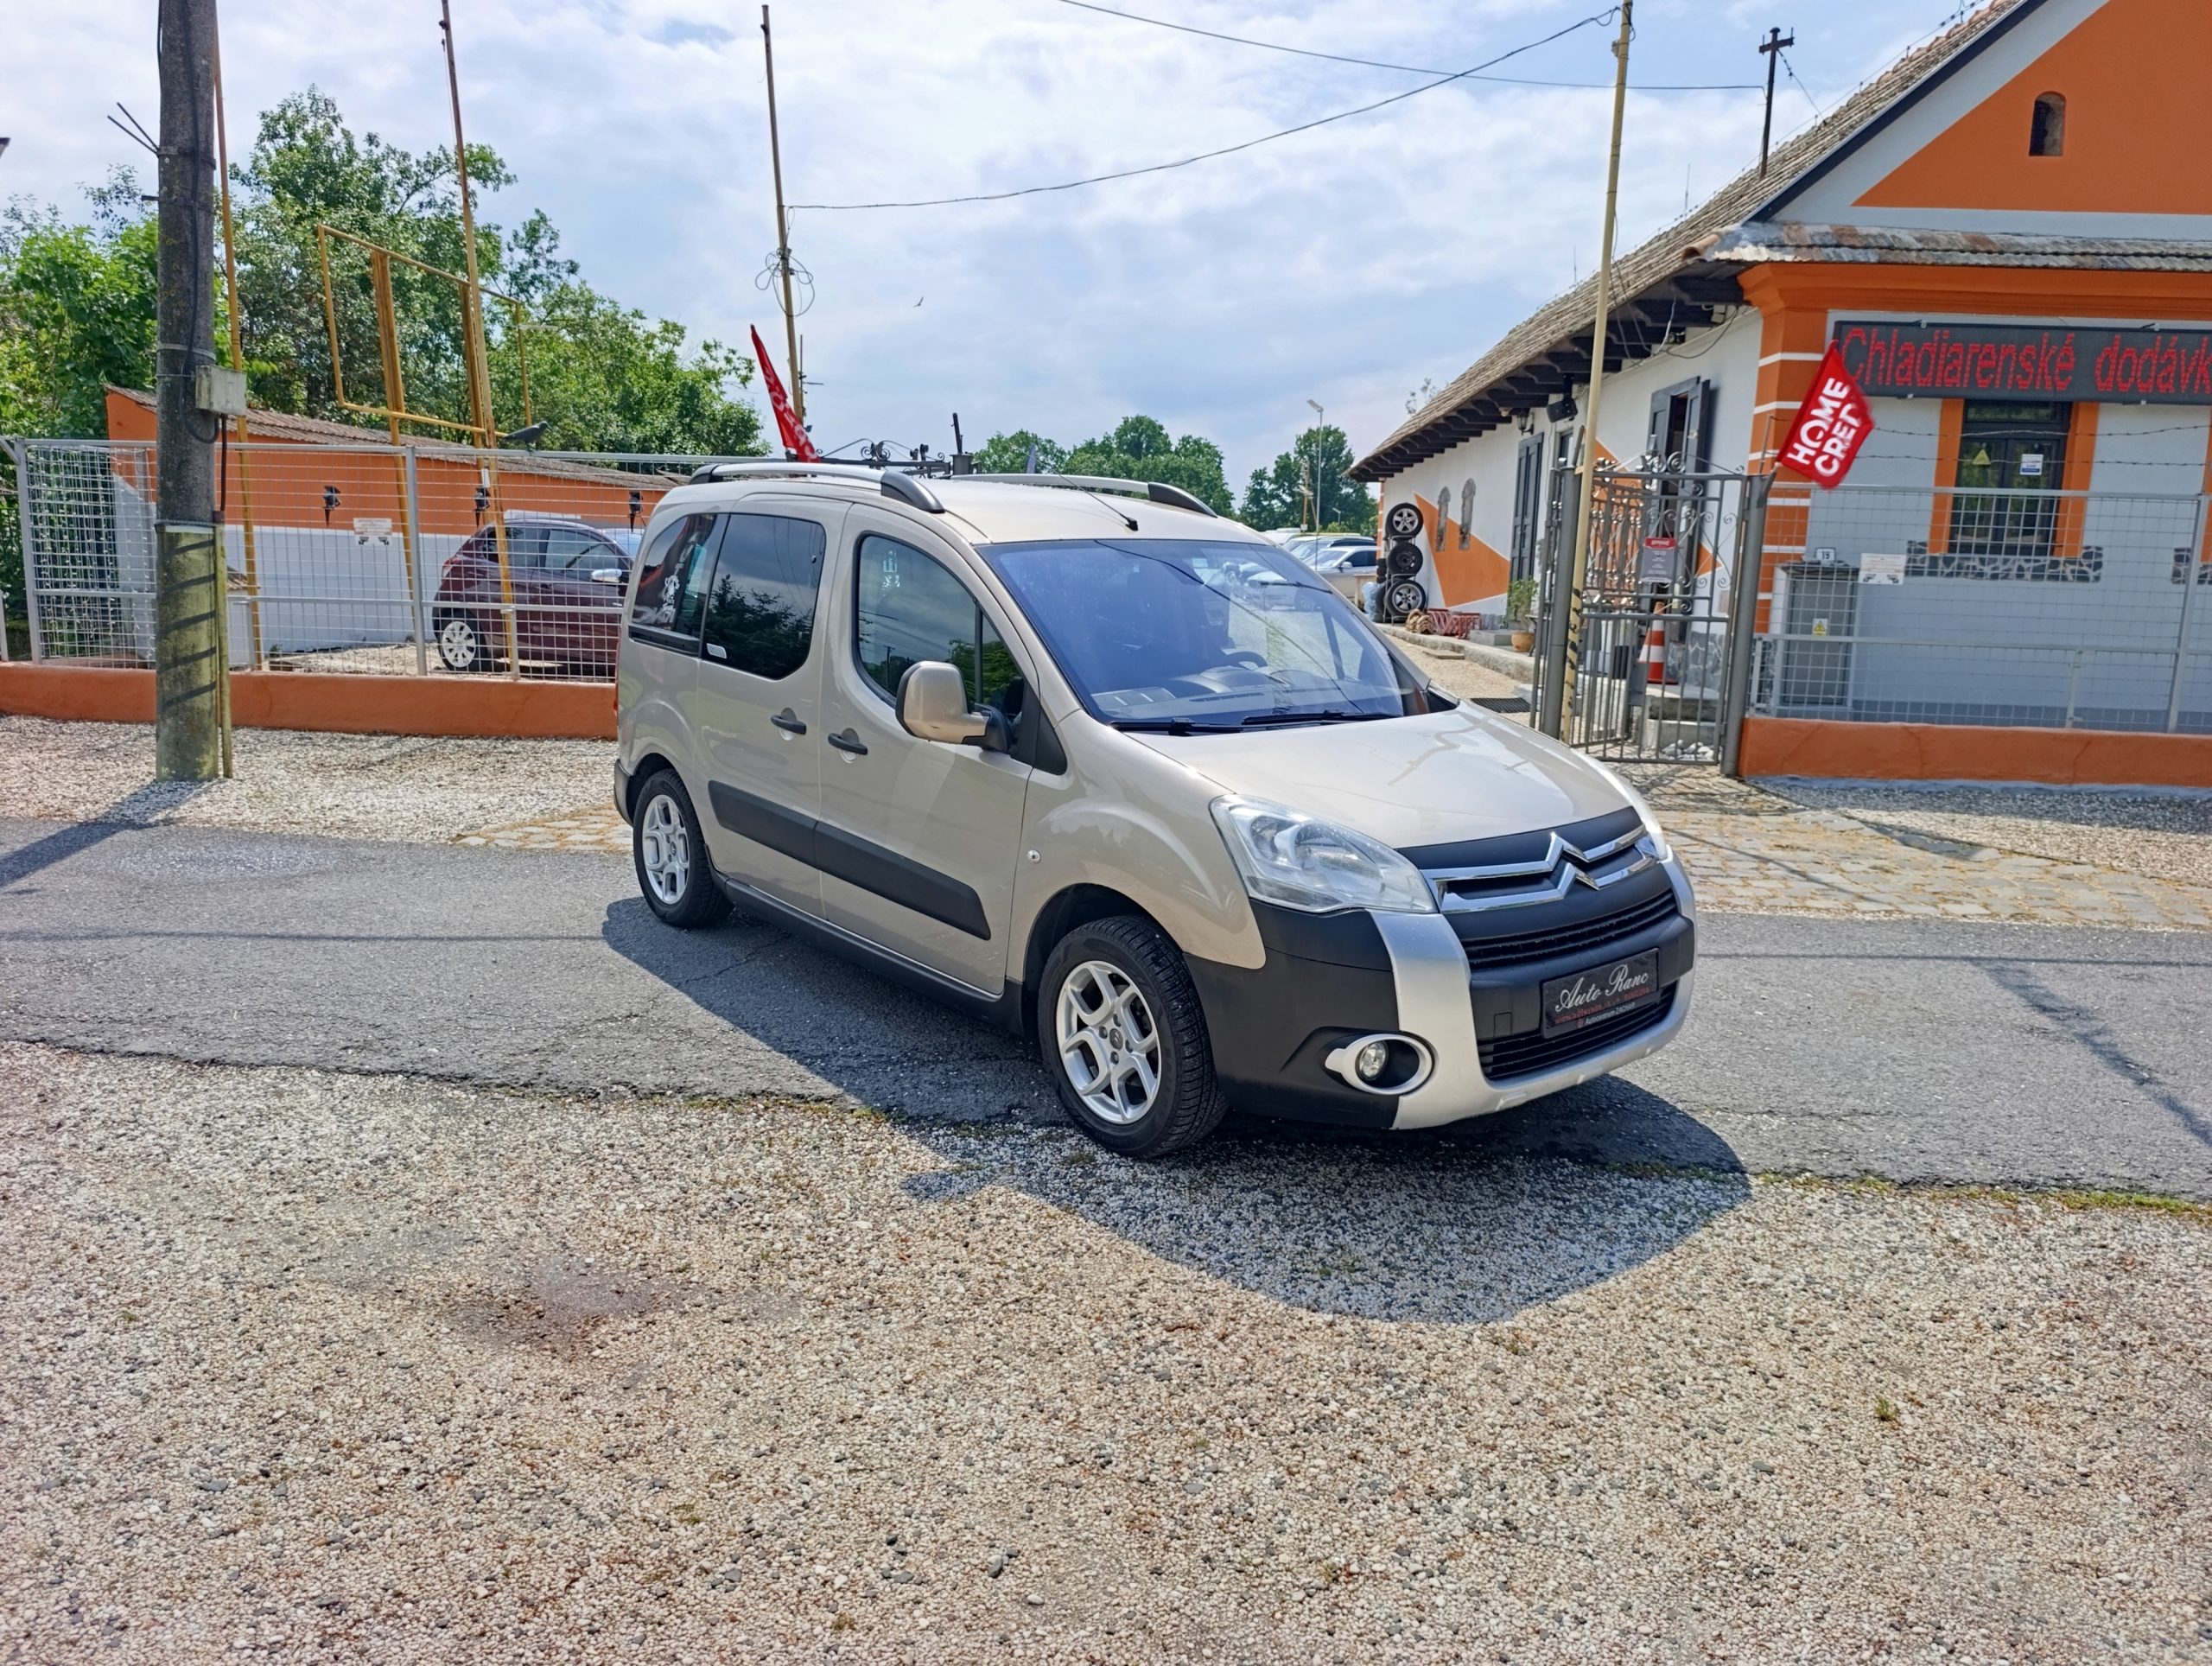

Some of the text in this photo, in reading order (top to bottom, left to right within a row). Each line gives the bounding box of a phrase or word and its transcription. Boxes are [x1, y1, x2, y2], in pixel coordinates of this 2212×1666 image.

[1841, 327, 2075, 391] Chladiarenské
[1786, 378, 1850, 465] HOME
[1555, 976, 1602, 1012] Auto
